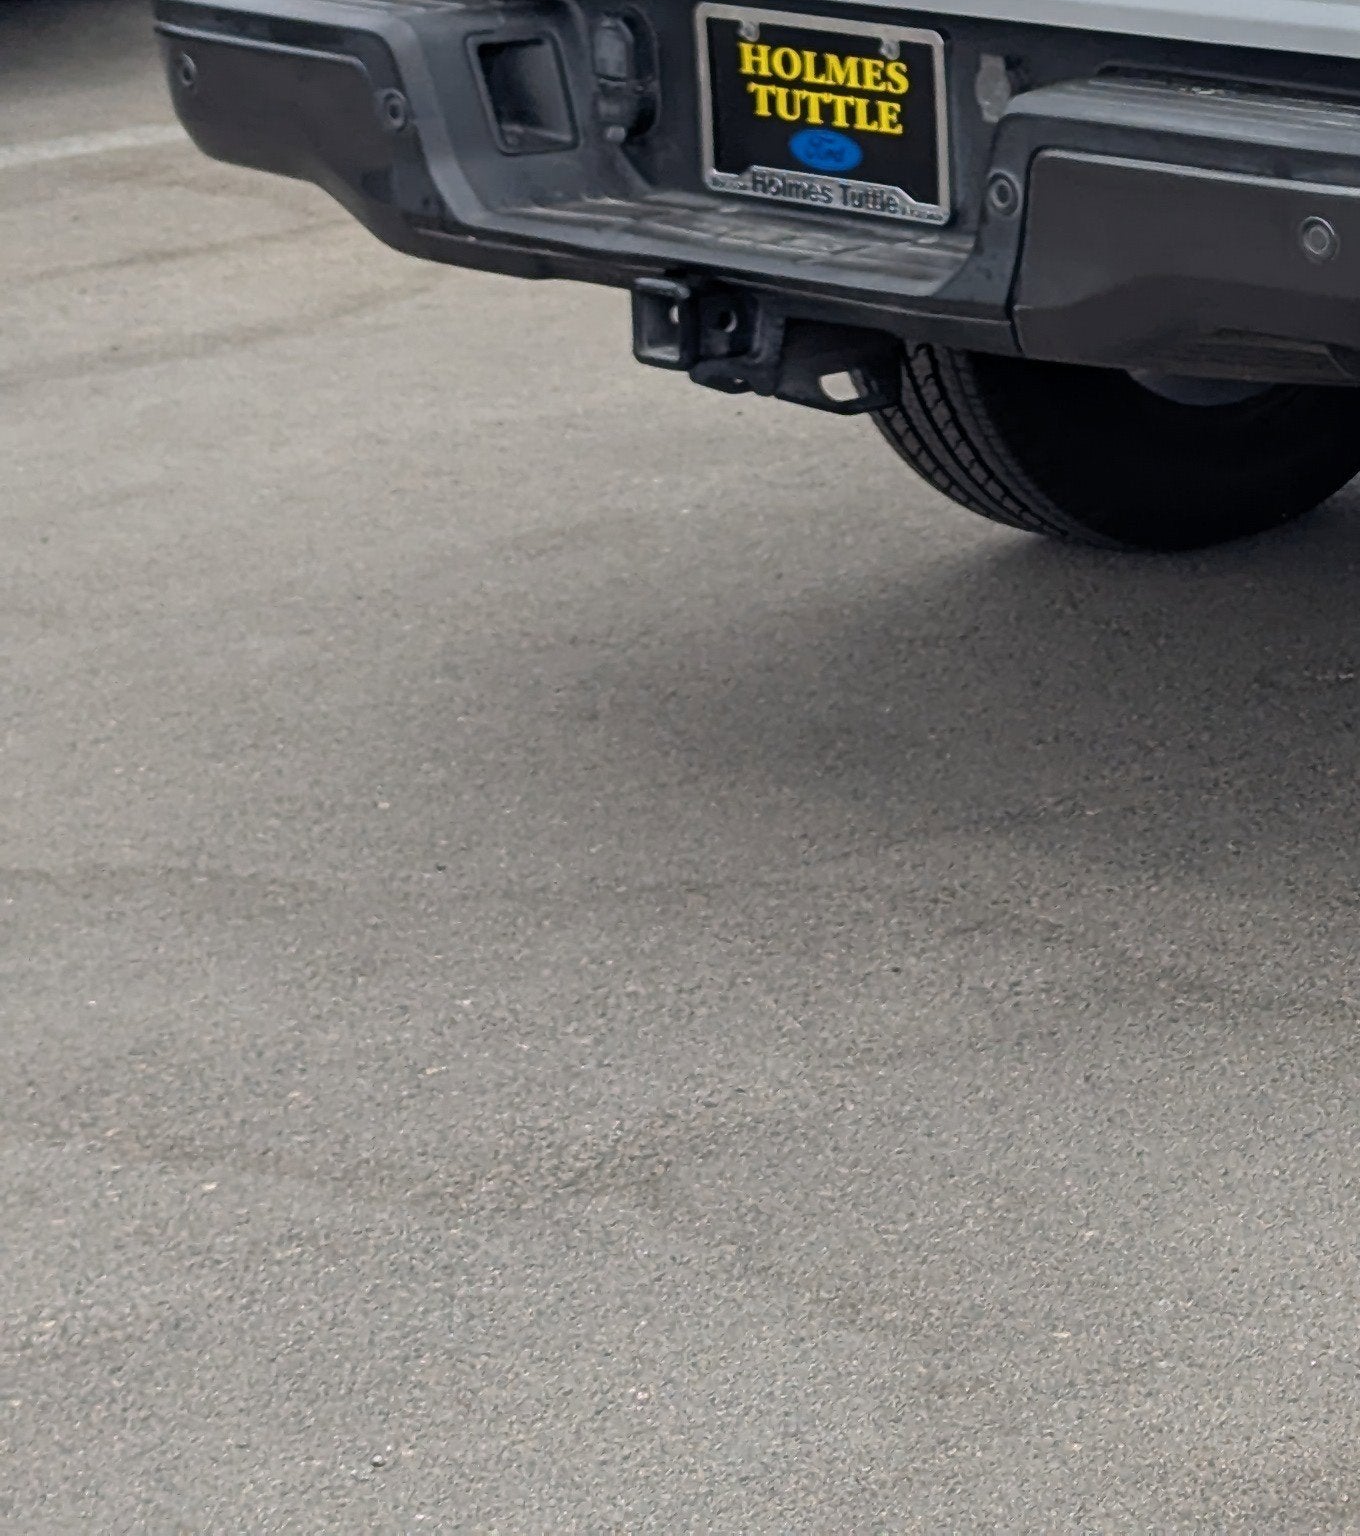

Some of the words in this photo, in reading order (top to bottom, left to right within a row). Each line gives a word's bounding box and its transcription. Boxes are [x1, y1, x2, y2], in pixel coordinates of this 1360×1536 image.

[738, 41, 909, 95] HOLMES
[746, 81, 904, 136] TUTTLE
[751, 171, 833, 205] Holmes
[838, 183, 900, 213] Tuttle
